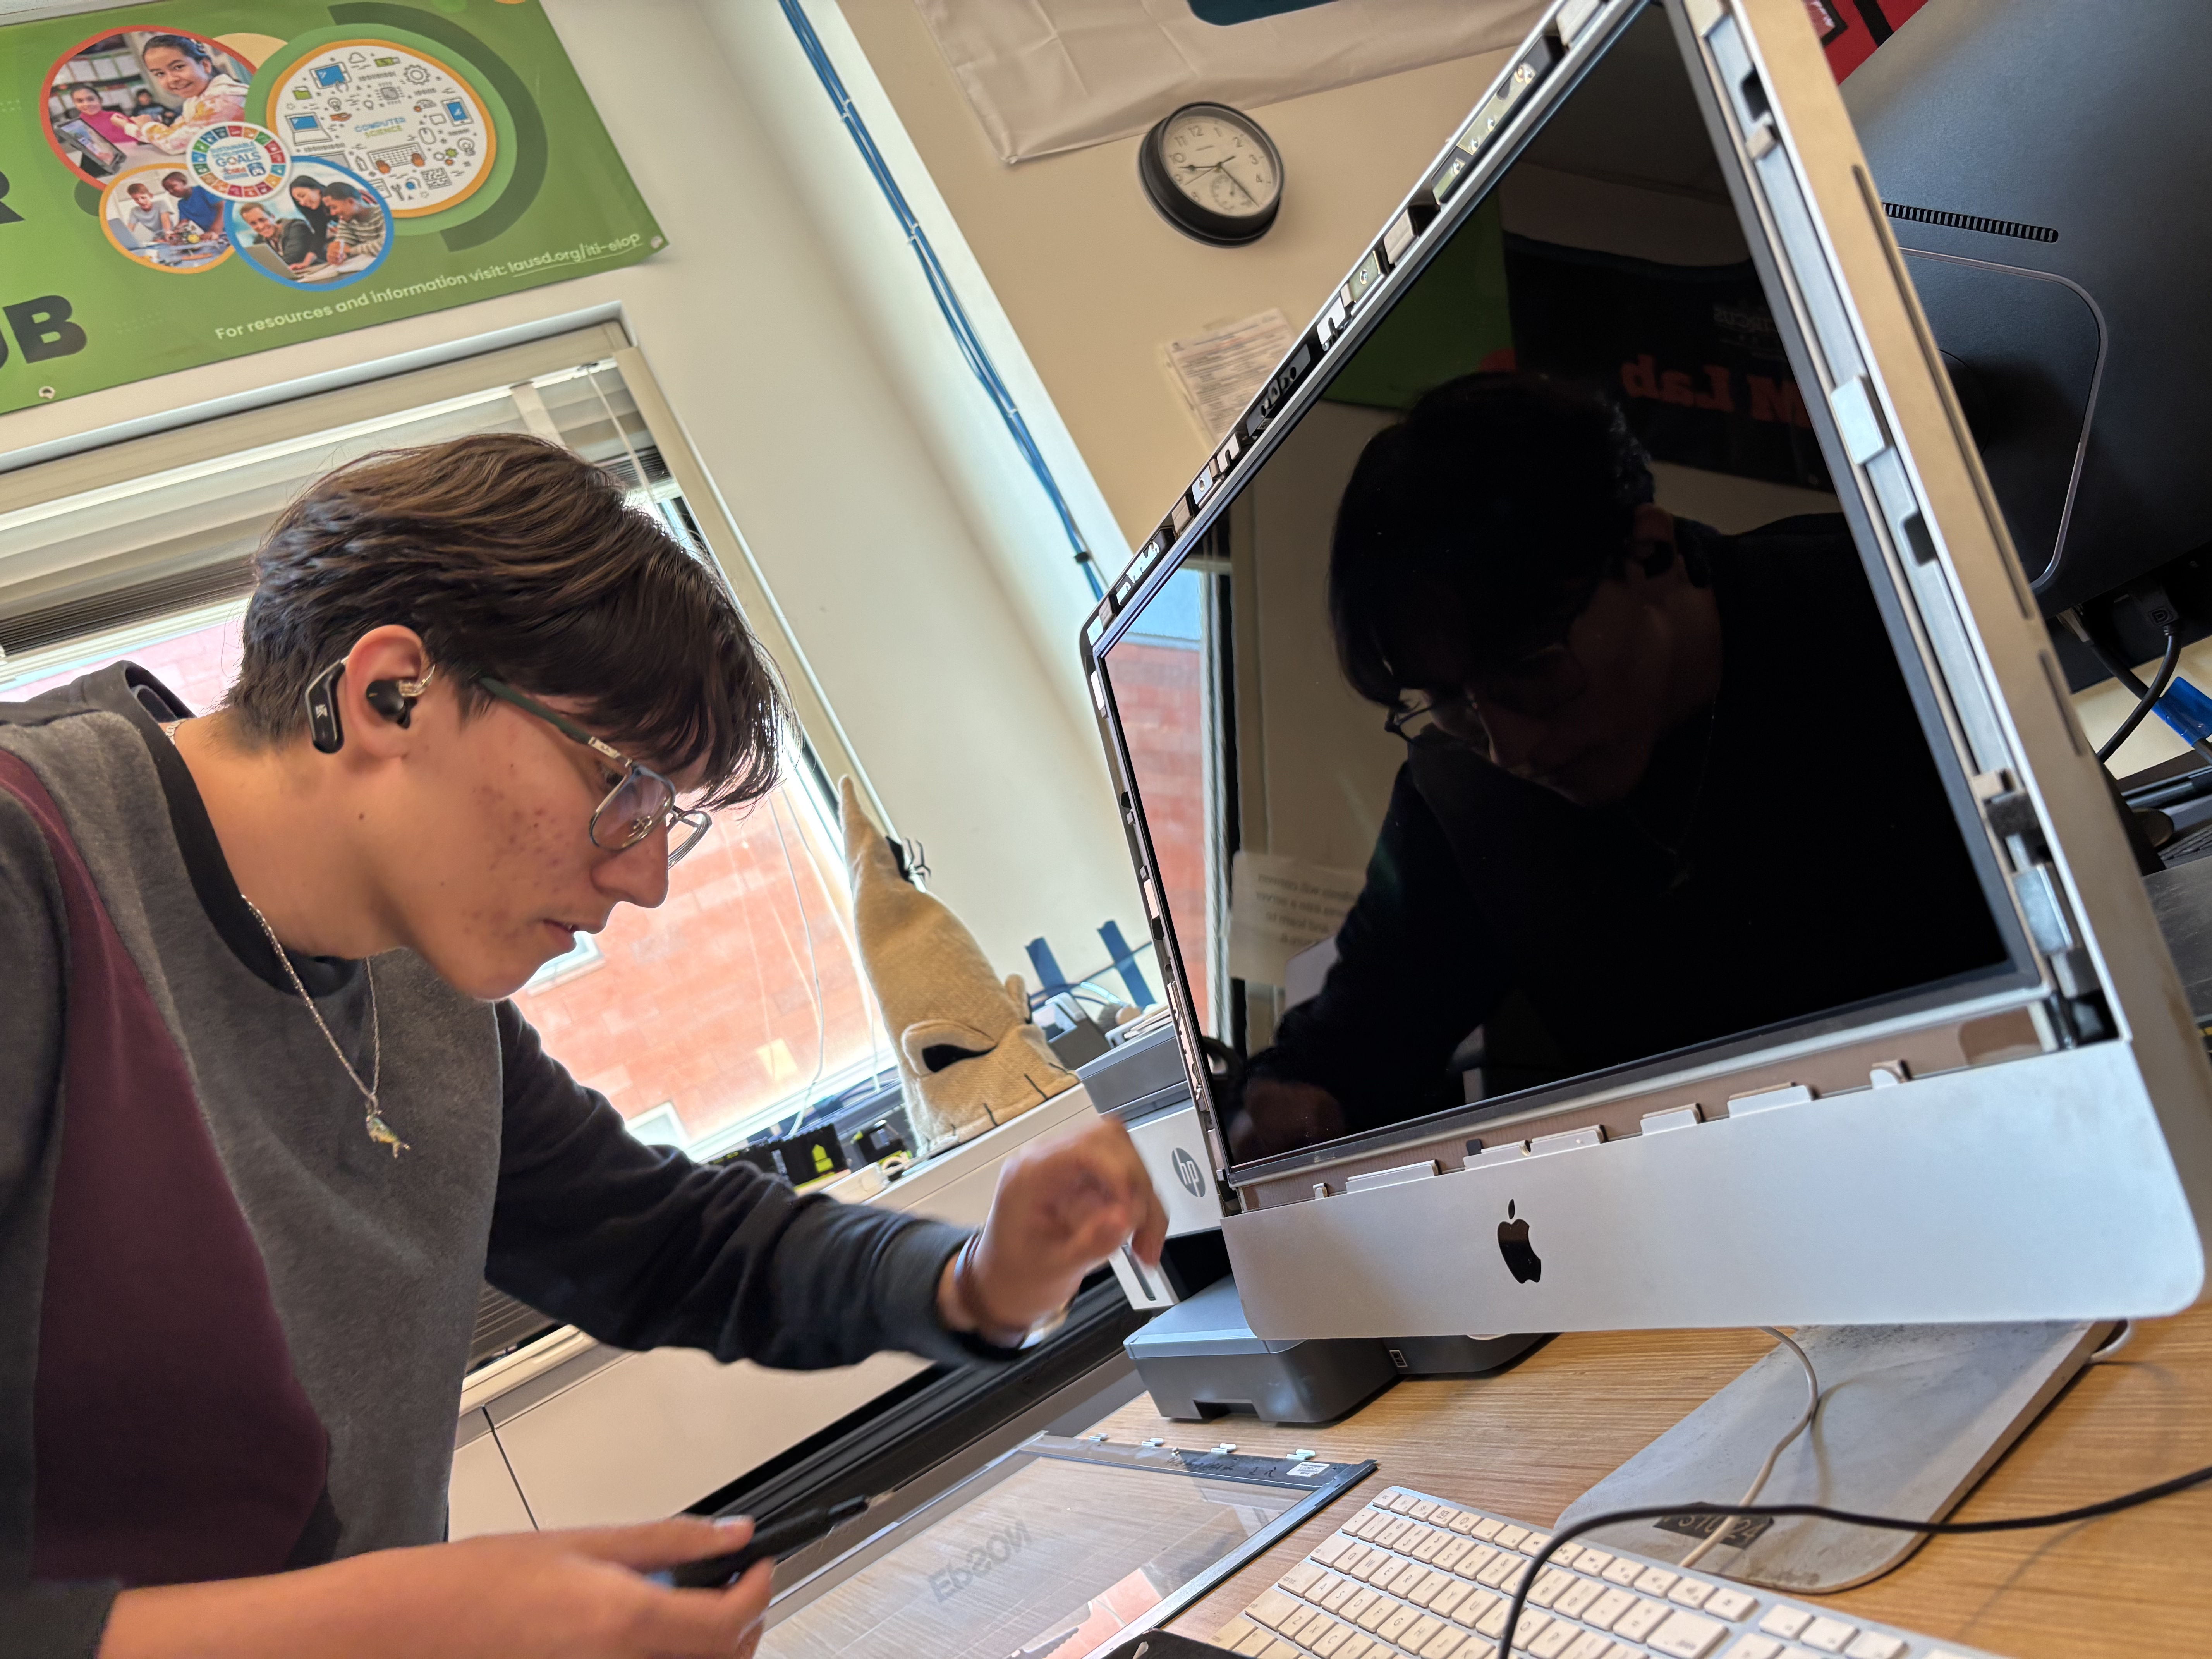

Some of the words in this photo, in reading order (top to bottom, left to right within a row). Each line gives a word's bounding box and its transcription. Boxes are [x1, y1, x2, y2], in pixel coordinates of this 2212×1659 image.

[1188, 125, 1204, 137] 12
[1214, 127, 1223, 137] 1
[1174, 136, 1188, 146] 11
[1232, 136, 1243, 148] 2
[216, 152, 262, 167] GOALS
[1249, 154, 1259, 165] 3
[1255, 174, 1262, 183] 4
[214, 325, 244, 340] For
[247, 304, 334, 333] resources
[335, 293, 371, 313] and
[372, 271, 468, 304] information
[469, 265, 507, 282] visit:
[508, 232, 641, 274] lausd.org/iti-elop
[0, 295, 87, 371] B
[1173, 1147, 1201, 1198] hp
[1365, 1559, 1376, 1568] W
[1384, 1567, 1393, 1575] E
[1403, 1574, 1413, 1583] R
[1425, 1583, 1434, 1591] T
[1446, 1590, 1456, 1600] Y
[1373, 1607, 1383, 1616] F
[1393, 1617, 1403, 1626] G
[1292, 1616, 1303, 1625] Z
[1309, 1624, 1318, 1634] X
[1328, 1635, 1338, 1644] C
